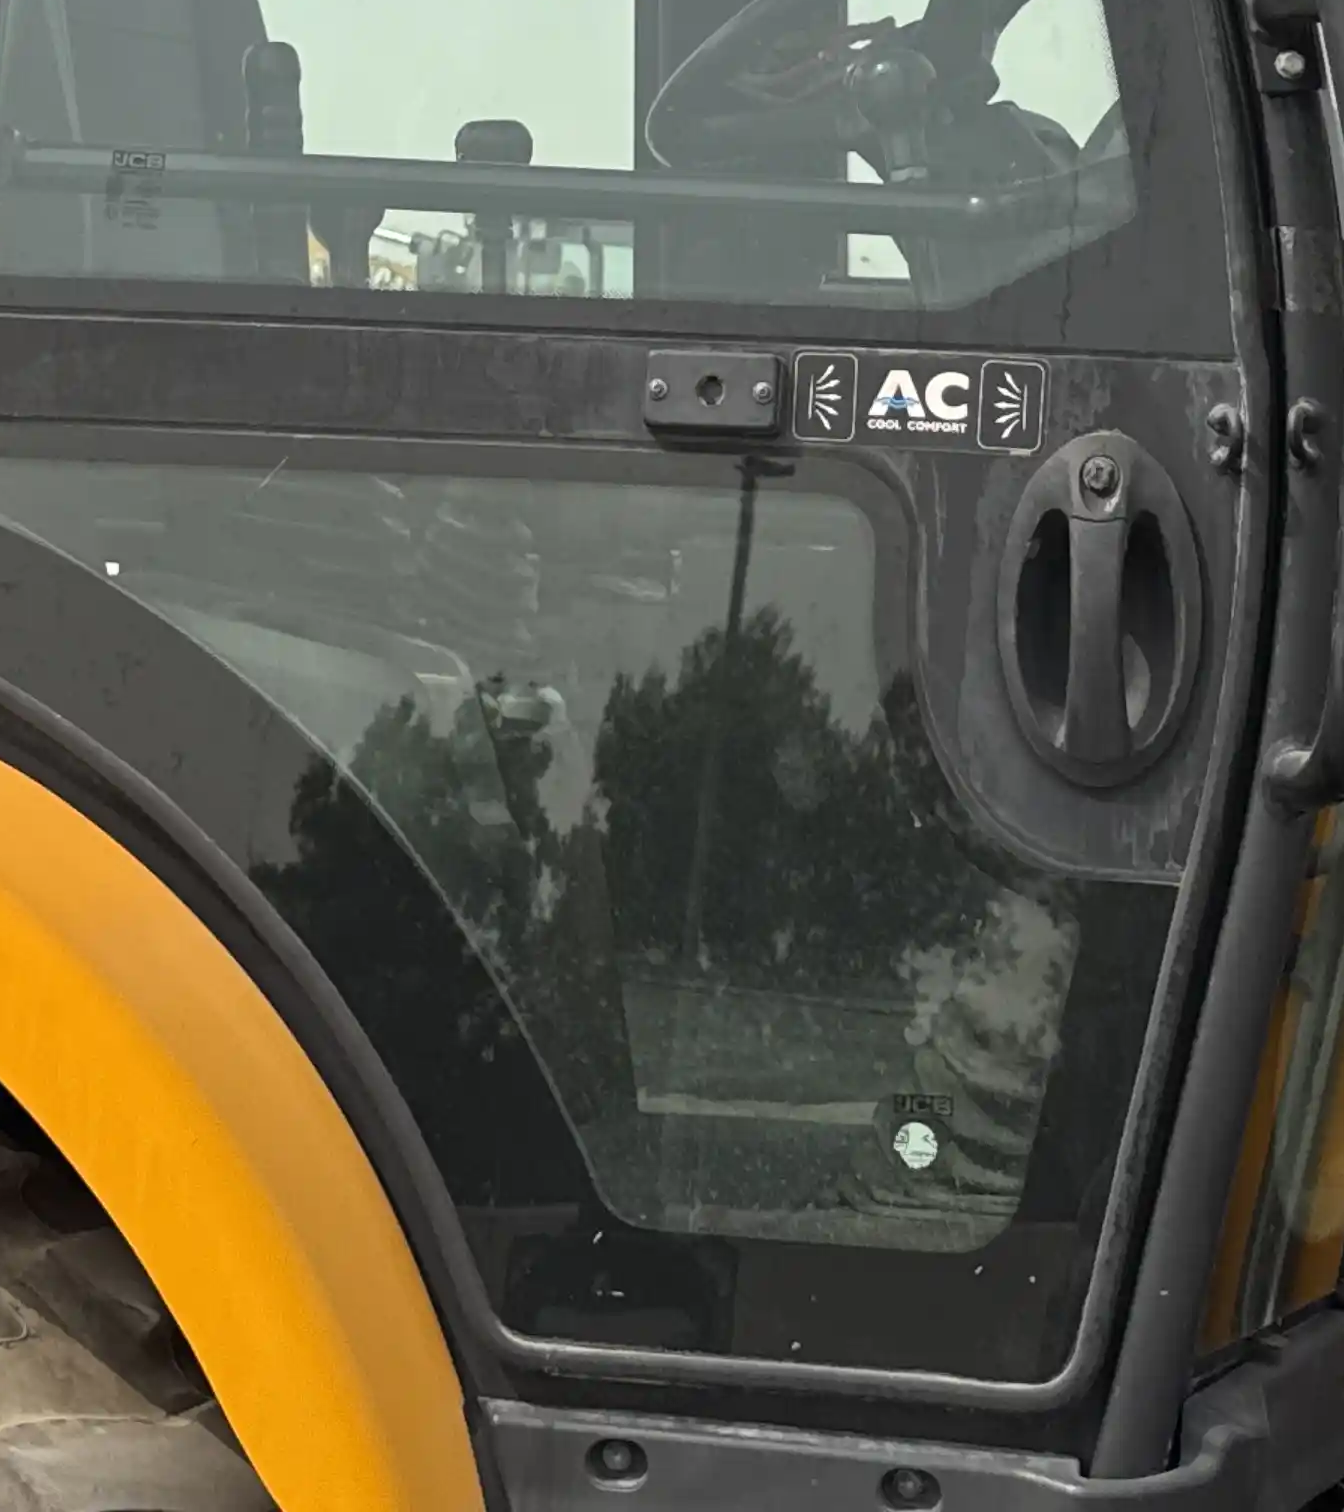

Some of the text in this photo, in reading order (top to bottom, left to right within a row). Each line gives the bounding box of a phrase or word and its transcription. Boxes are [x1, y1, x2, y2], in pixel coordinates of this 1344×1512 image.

[114, 151, 164, 169] JCB
[867, 369, 971, 420] AC
[867, 419, 968, 435] COOL COMFORT
[895, 1095, 952, 1116] JCB
